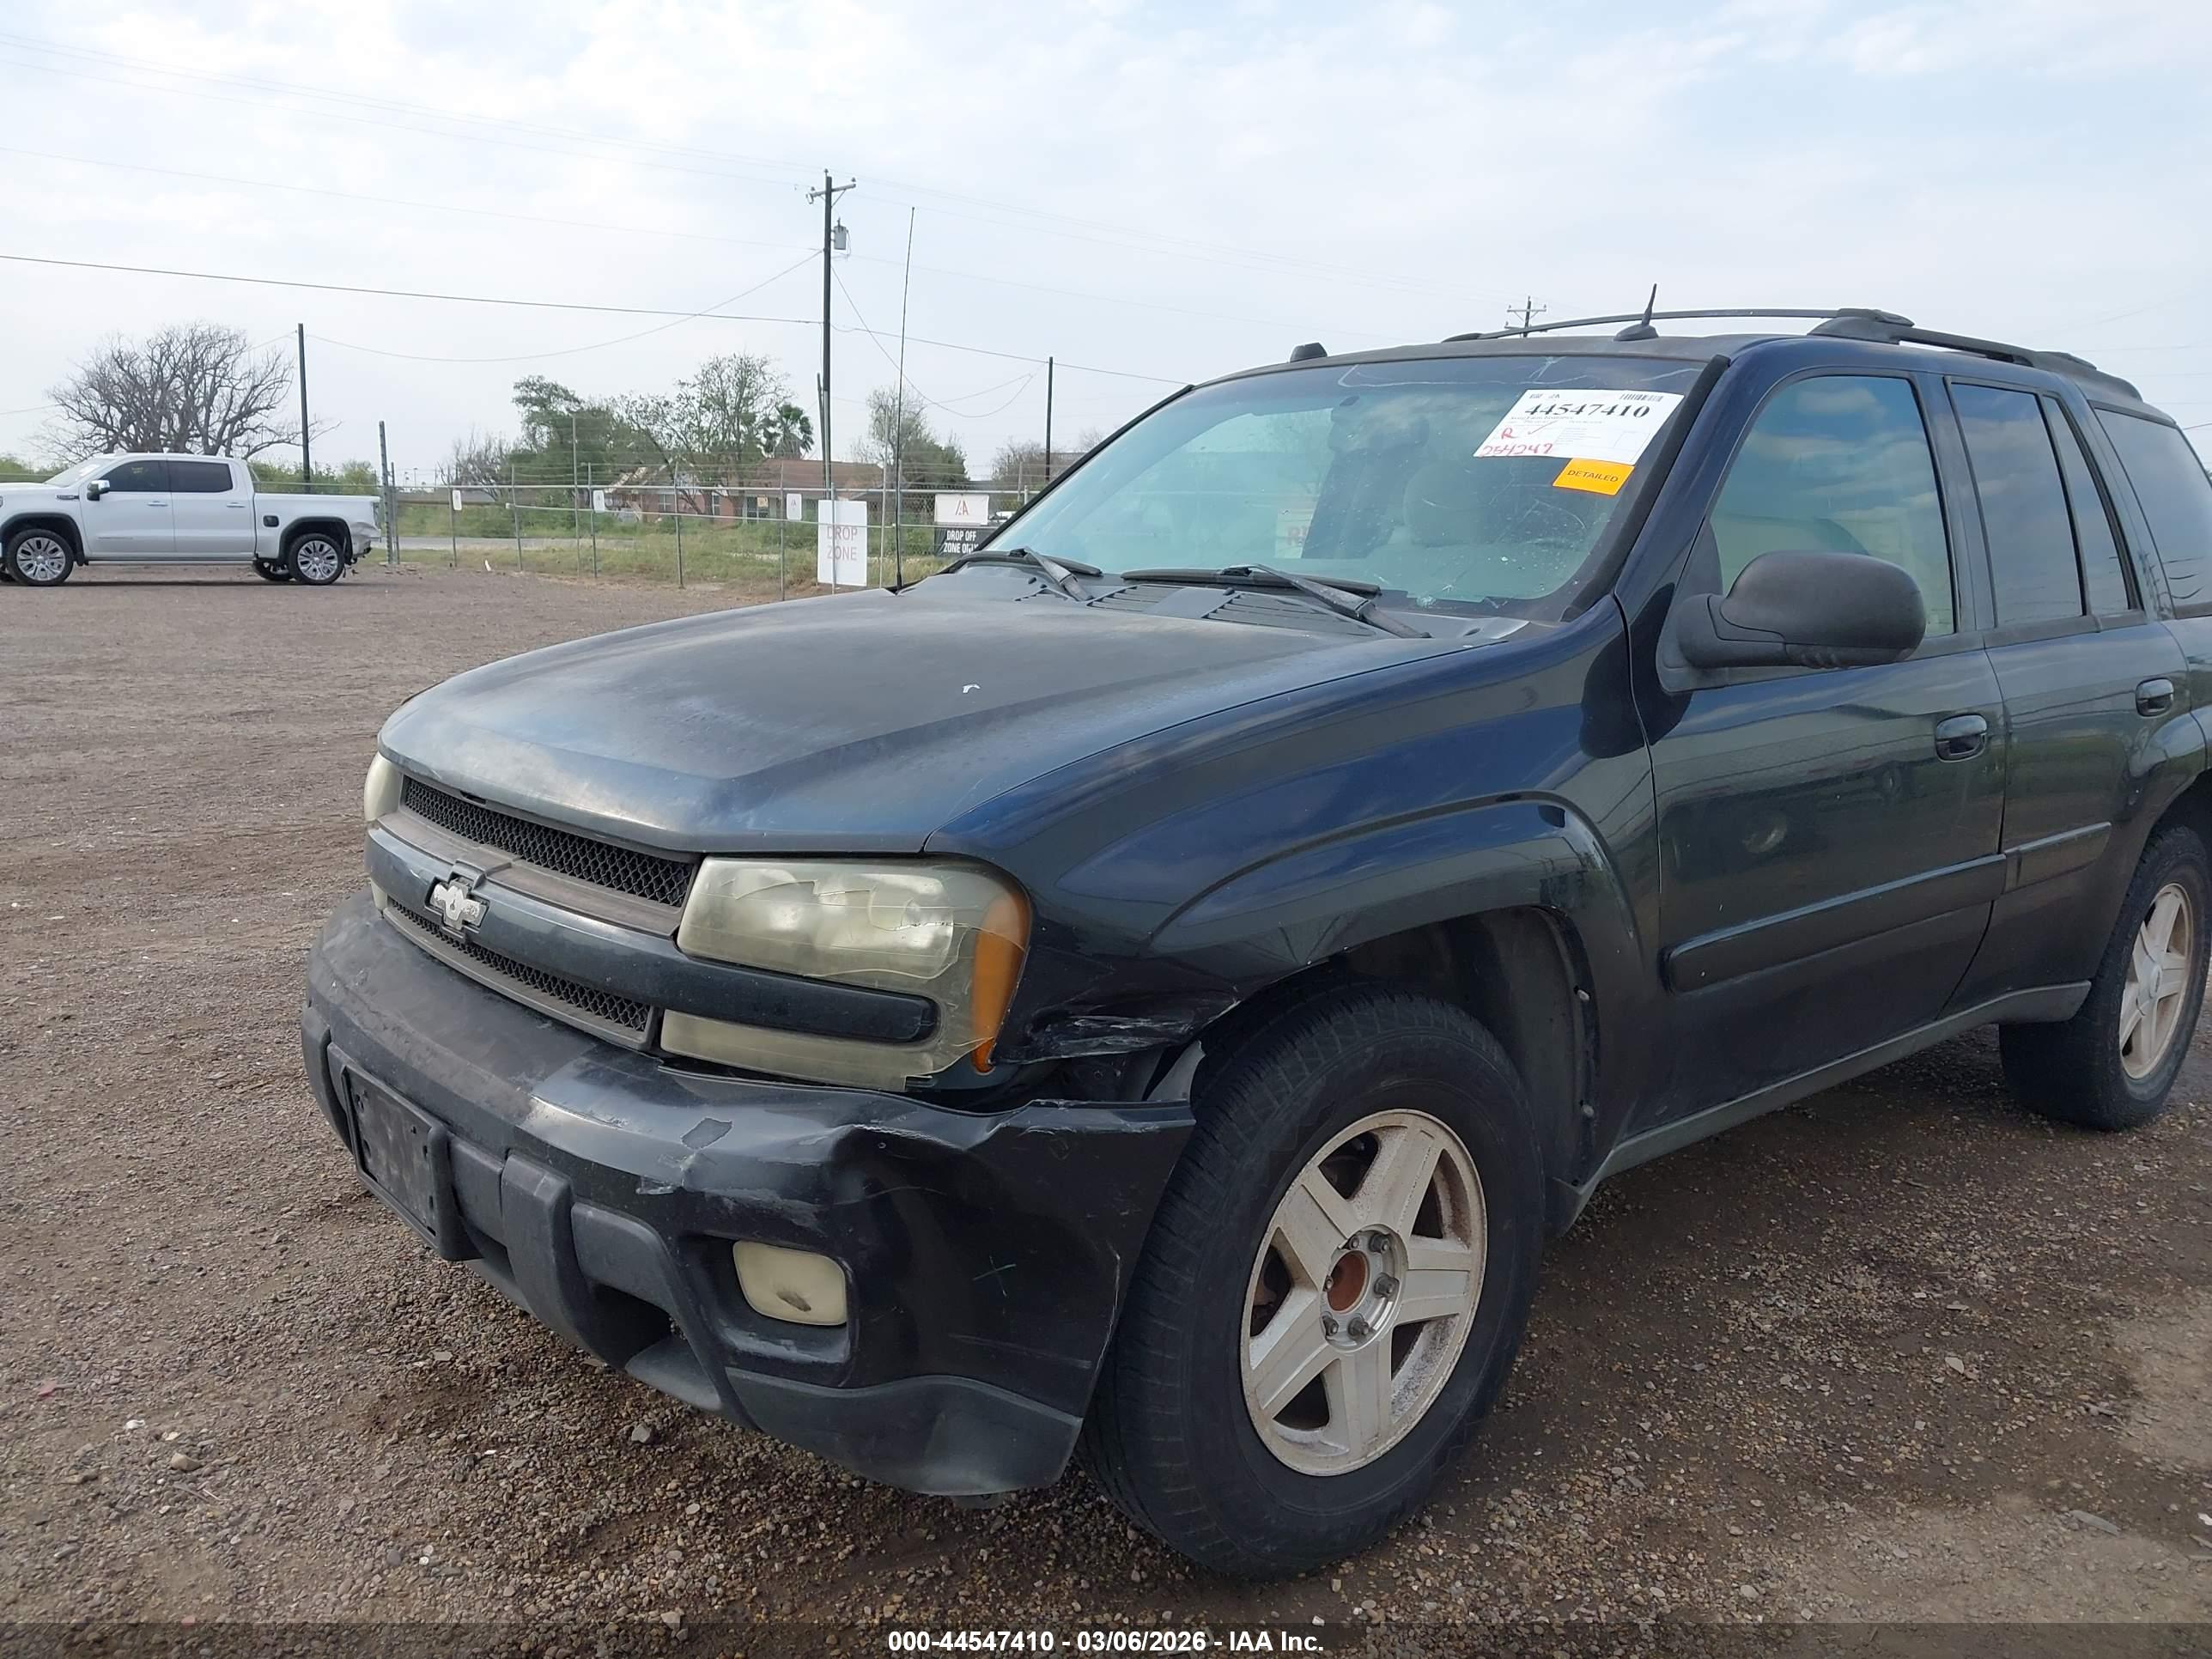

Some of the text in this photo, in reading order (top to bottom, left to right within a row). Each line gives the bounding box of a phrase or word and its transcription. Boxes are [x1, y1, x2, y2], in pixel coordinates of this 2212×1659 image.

[1524, 404, 1650, 417] 44547410
[1566, 470, 1620, 483] DETAILED
[826, 525, 858, 541] DROP
[946, 530, 977, 542] DROP OFF
[826, 545, 858, 561] ZONE
[943, 542, 961, 553] ZONE
